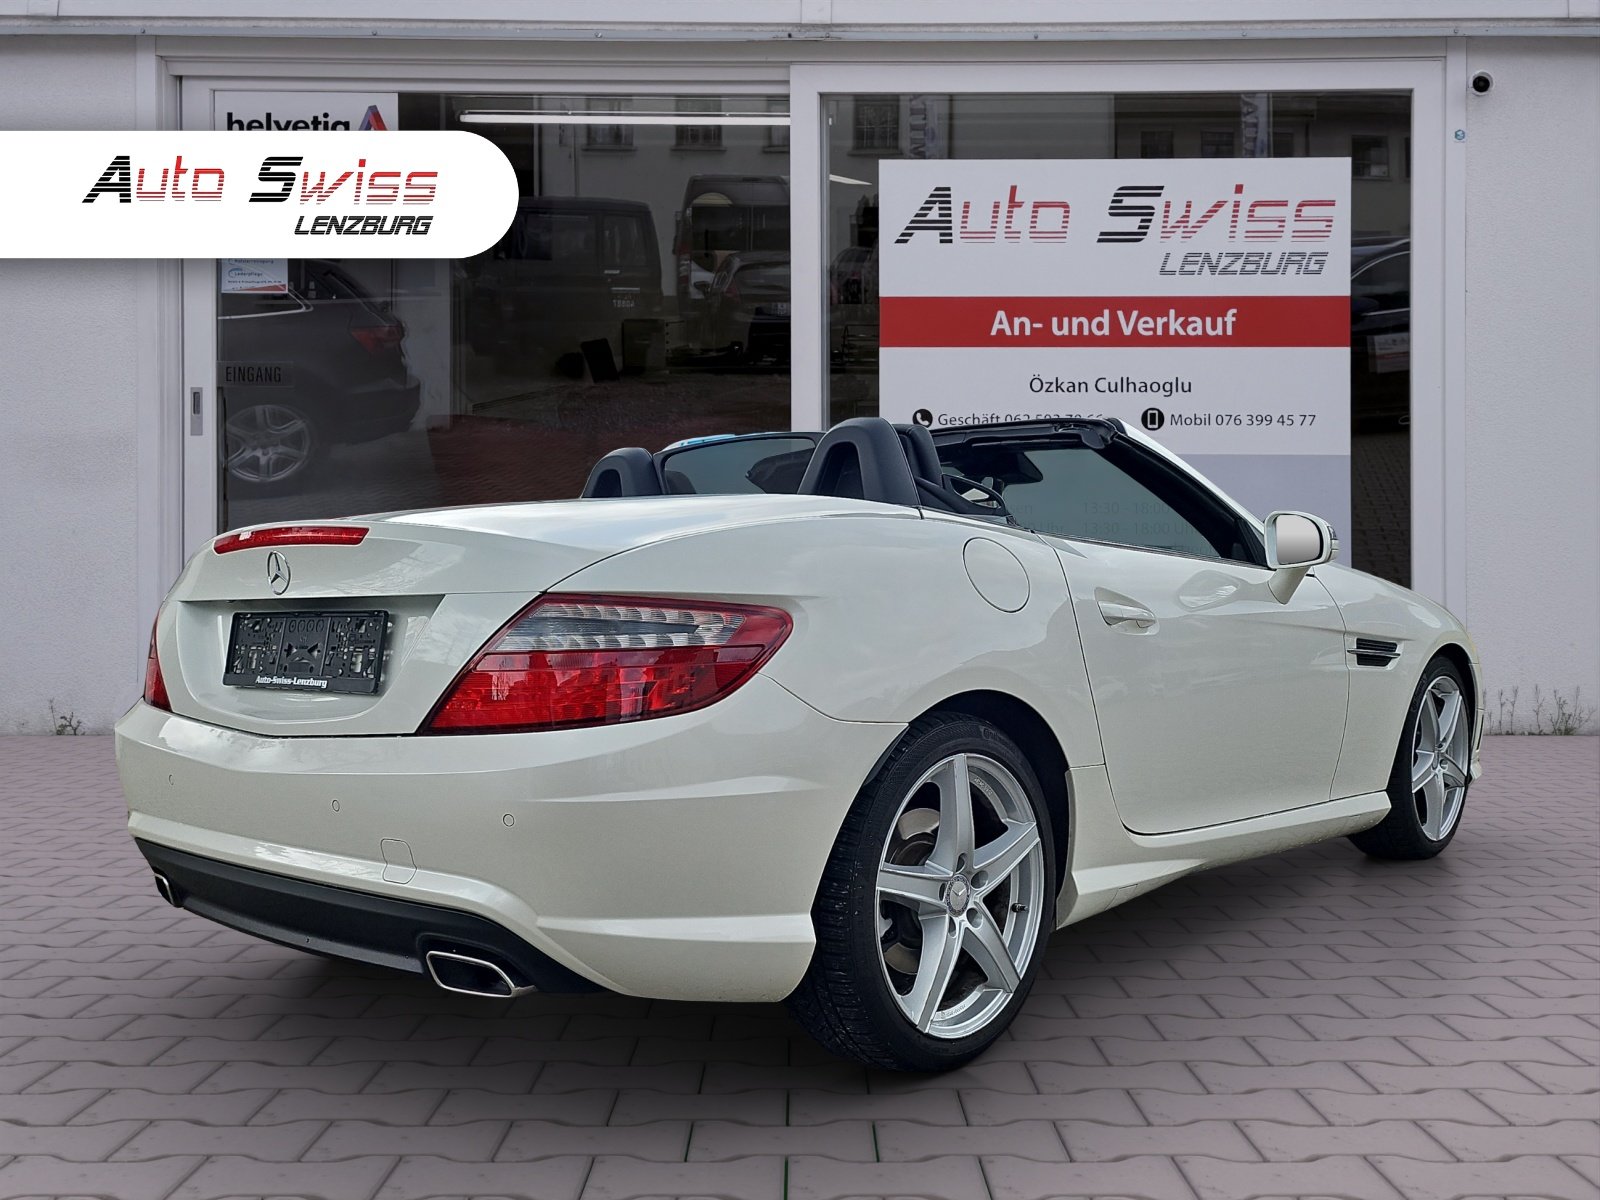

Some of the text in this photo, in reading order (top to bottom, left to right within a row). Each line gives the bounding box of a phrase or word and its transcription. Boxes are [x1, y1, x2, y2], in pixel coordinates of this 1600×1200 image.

[894, 183, 1336, 244] Auto Swiss
[1159, 251, 1329, 276] LENZBURG
[990, 309, 1238, 336] An- und Verkauf
[225, 366, 281, 382] EINGANG
[1029, 374, 1192, 398] Özkan Culhaoglu
[938, 413, 1000, 426] Geschäft
[1170, 413, 1316, 426] Mobil 076 399 45 77
[255, 675, 328, 688] Auto-Swiss-Lenzburg
